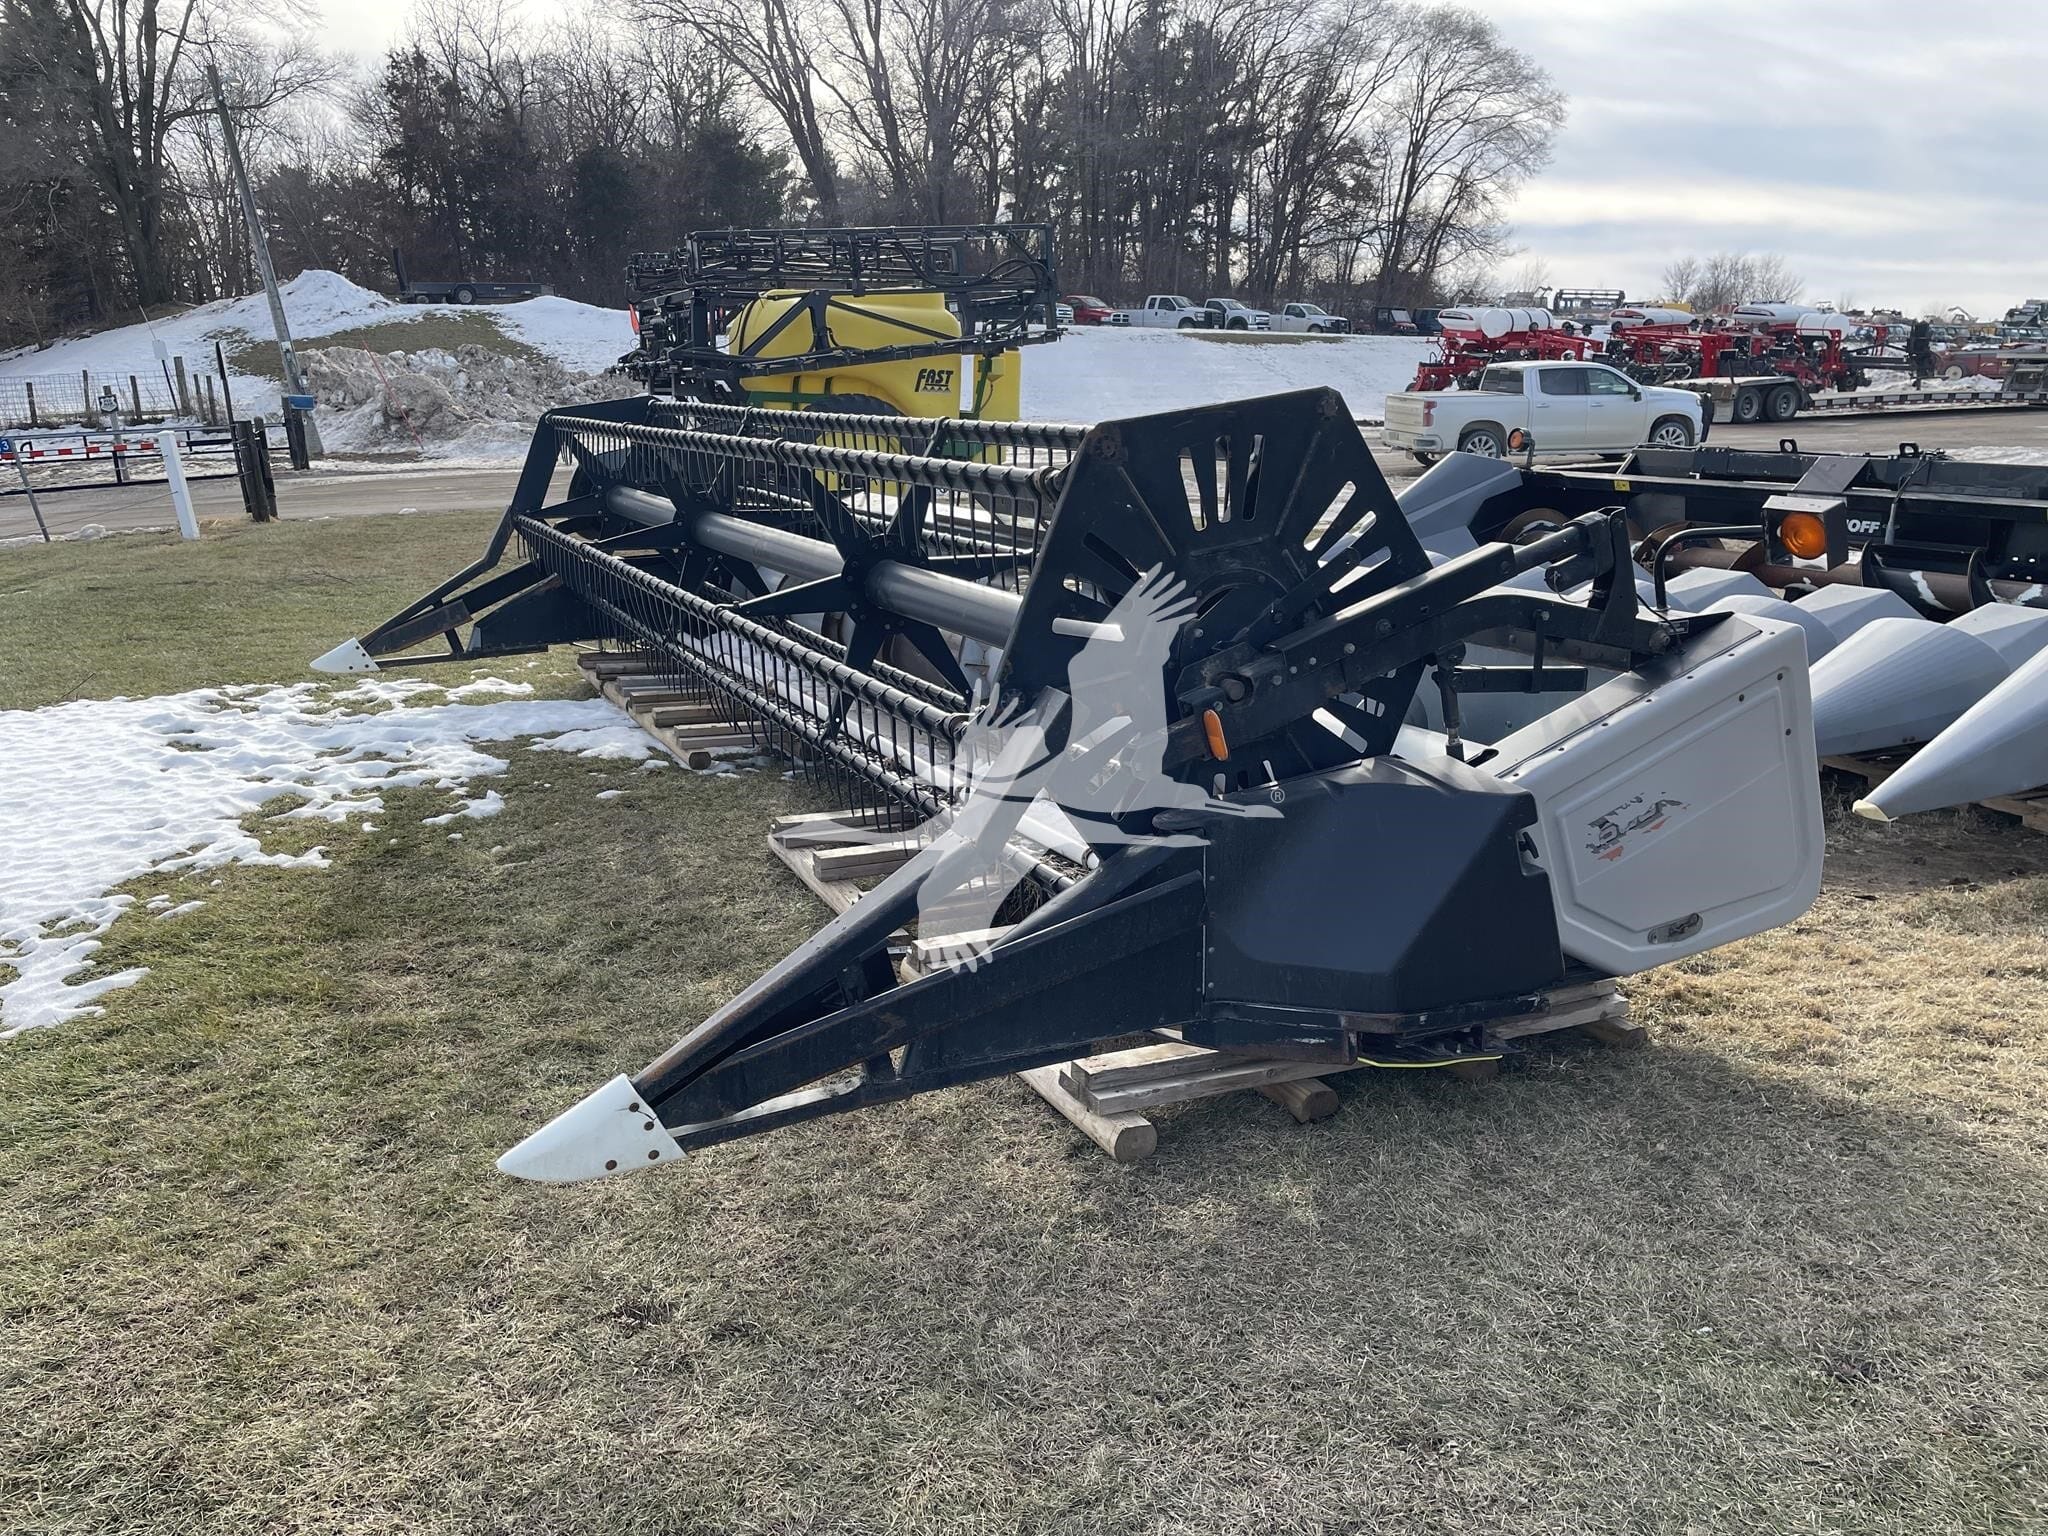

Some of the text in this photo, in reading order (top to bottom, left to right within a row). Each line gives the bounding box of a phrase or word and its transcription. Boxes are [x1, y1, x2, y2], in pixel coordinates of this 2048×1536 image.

[914, 368, 954, 392] FAST
[0, 440, 10, 451] 3
[1846, 519, 1881, 534] OFF
